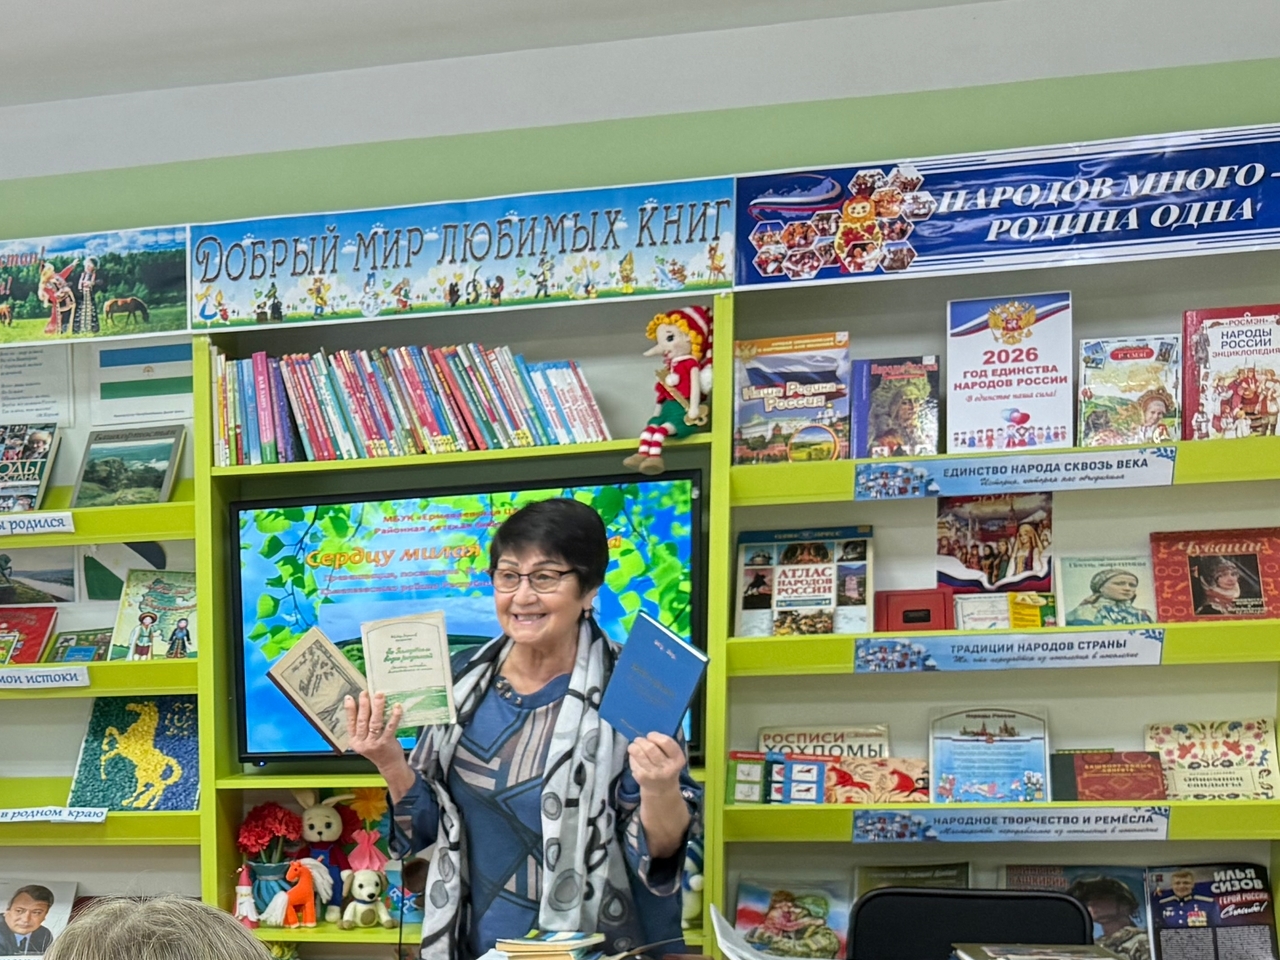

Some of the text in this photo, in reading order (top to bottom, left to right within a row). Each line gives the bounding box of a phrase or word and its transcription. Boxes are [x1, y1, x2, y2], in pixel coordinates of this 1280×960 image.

[937, 162, 1265, 215] НАРОДОВ МНОГО
[986, 198, 1254, 242] РОДИНА ОДНА
[195, 199, 733, 285] ДОБРЫЙ МИР ЛЮБИМЫХ КНИГ
[1221, 328, 1272, 340] НАРОДЫ
[1221, 338, 1272, 350] РОССИИ
[982, 347, 1038, 365] 2026
[1212, 347, 1280, 358] ЭНЦИКЛОПЕДИЯ
[963, 365, 1058, 379] ГОД ЕДИНСТВА
[953, 375, 1068, 391] НАРОДОВ РОССИИ
[742, 386, 784, 400] Наша
[1035, 389, 1057, 398] сила!
[765, 395, 825, 412] Россия
[943, 458, 1148, 477] ЕДИНСТВО НАРОДА СКВОЗЬ ВЕКА
[9, 517, 66, 534] родился
[373, 526, 426, 535] Районная
[305, 543, 481, 570] Сердцу милая
[778, 567, 832, 579] АТЛАС
[777, 578, 833, 588] НАРОДОВ
[777, 586, 832, 595] РОССИИ
[950, 639, 1126, 654] ТРАДИЦИИ НАРОДОВ СТРАНЫ
[26, 673, 79, 683] истоки
[763, 732, 845, 744] РОСПИСИ
[1, 811, 8, 819] в
[10, 808, 62, 821] родном
[68, 809, 104, 821] краю
[933, 813, 1153, 825] НАРОДНОЕ ТВОРЧЕСТВО И РЕМЁСЛА
[1214, 868, 1256, 881] ИЛЬЯ
[1211, 879, 1263, 893] СИЗОВ
[1242, 892, 1268, 902] РОССИИ
